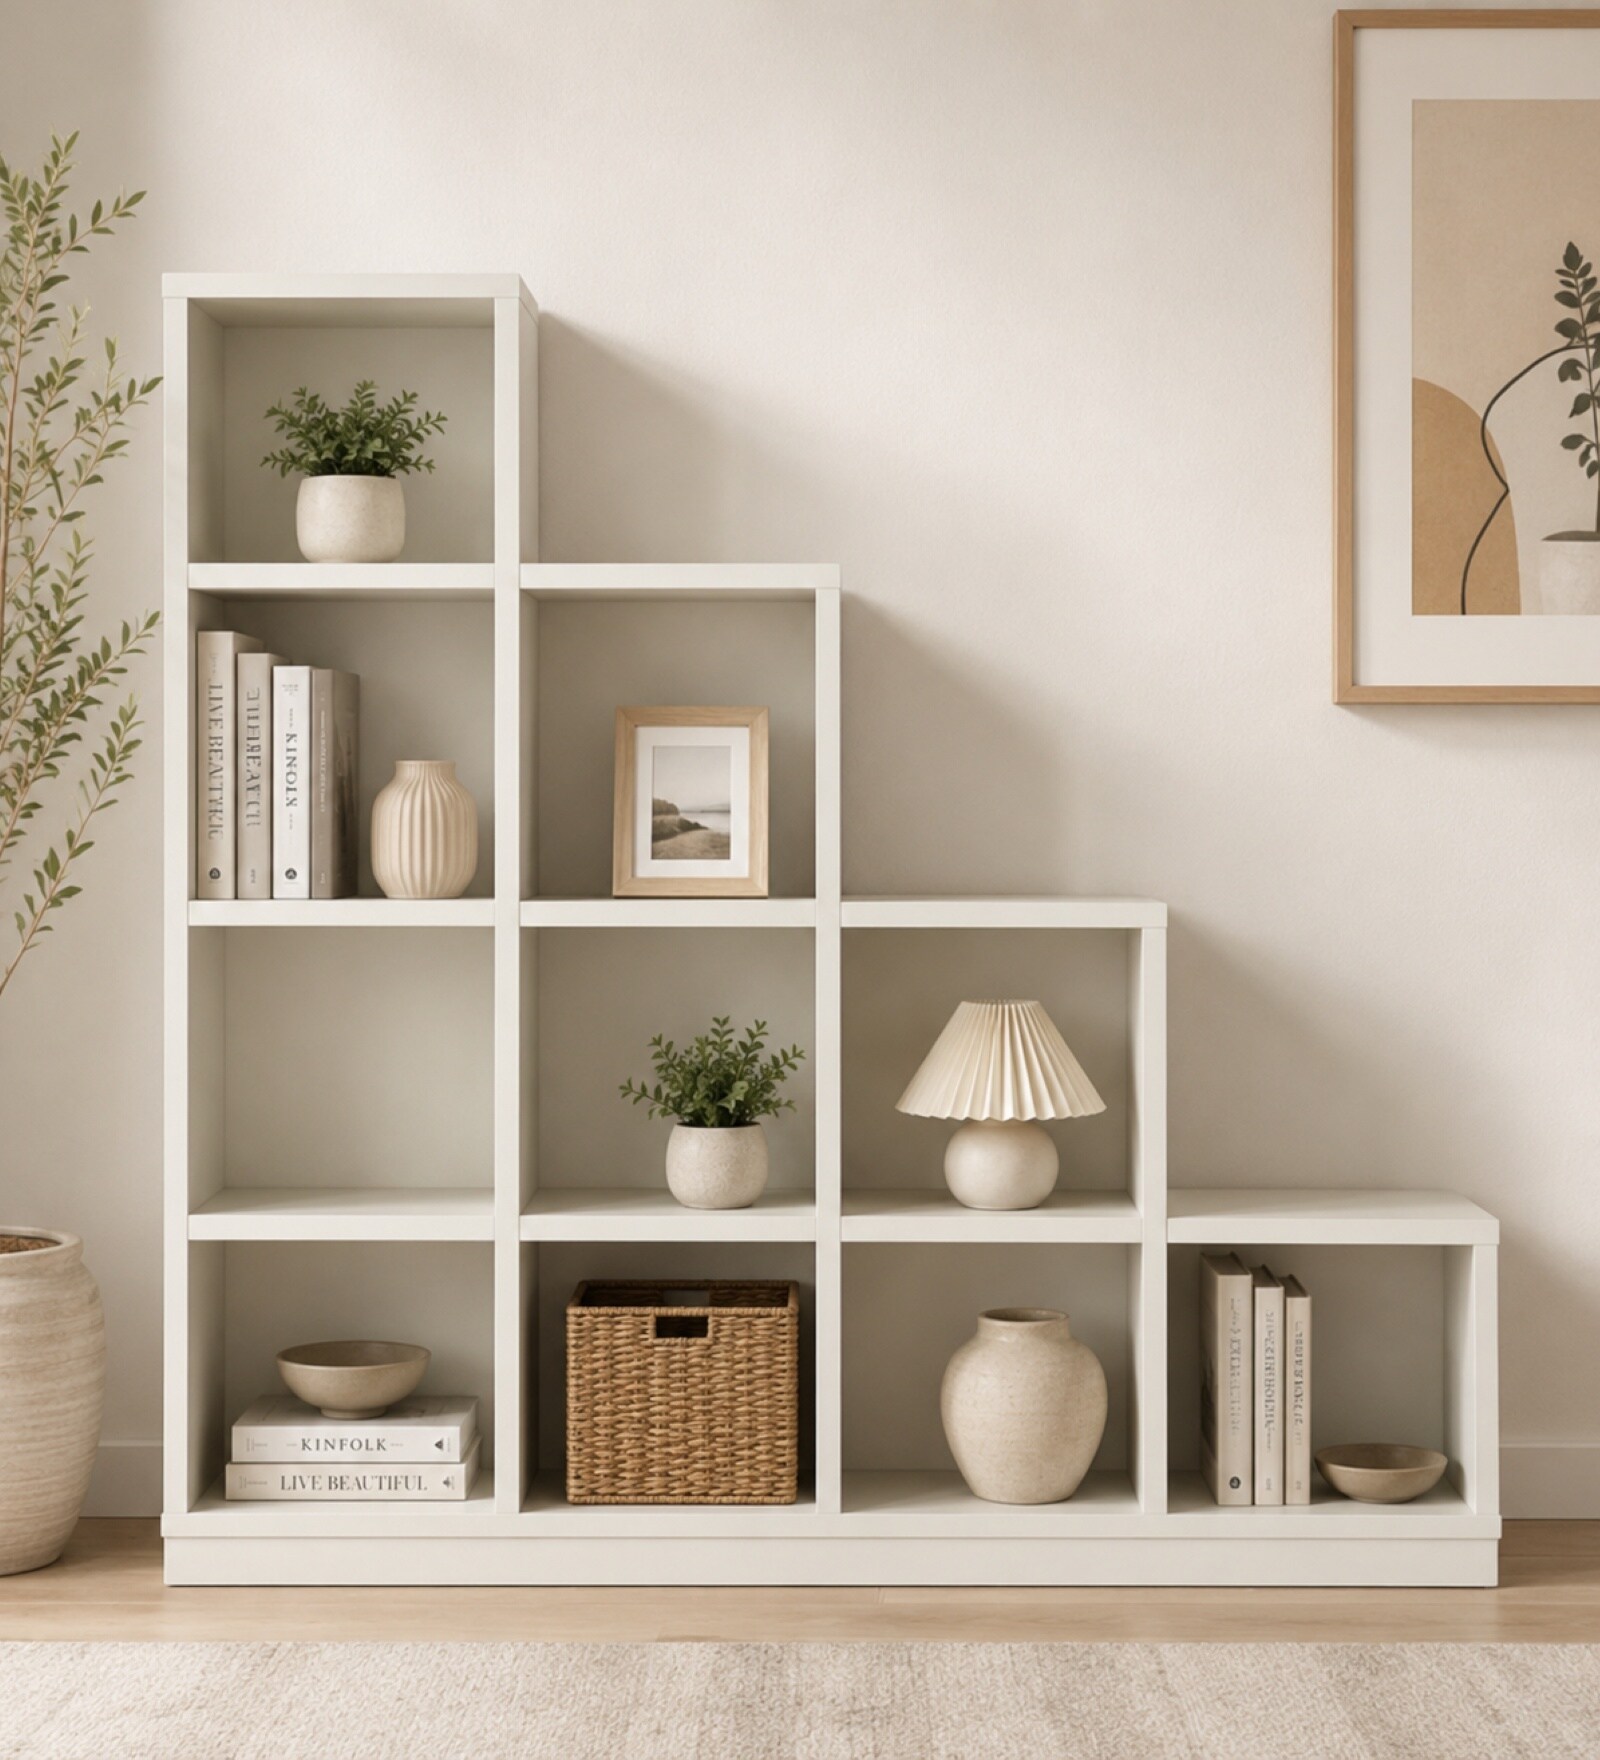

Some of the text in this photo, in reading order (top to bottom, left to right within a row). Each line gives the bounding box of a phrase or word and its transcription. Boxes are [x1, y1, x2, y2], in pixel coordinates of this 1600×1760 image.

[301, 1438, 387, 1451] KINFOLK
[280, 1475, 323, 1491] LIVE
[328, 1475, 428, 1491] BEAUTIFUL
